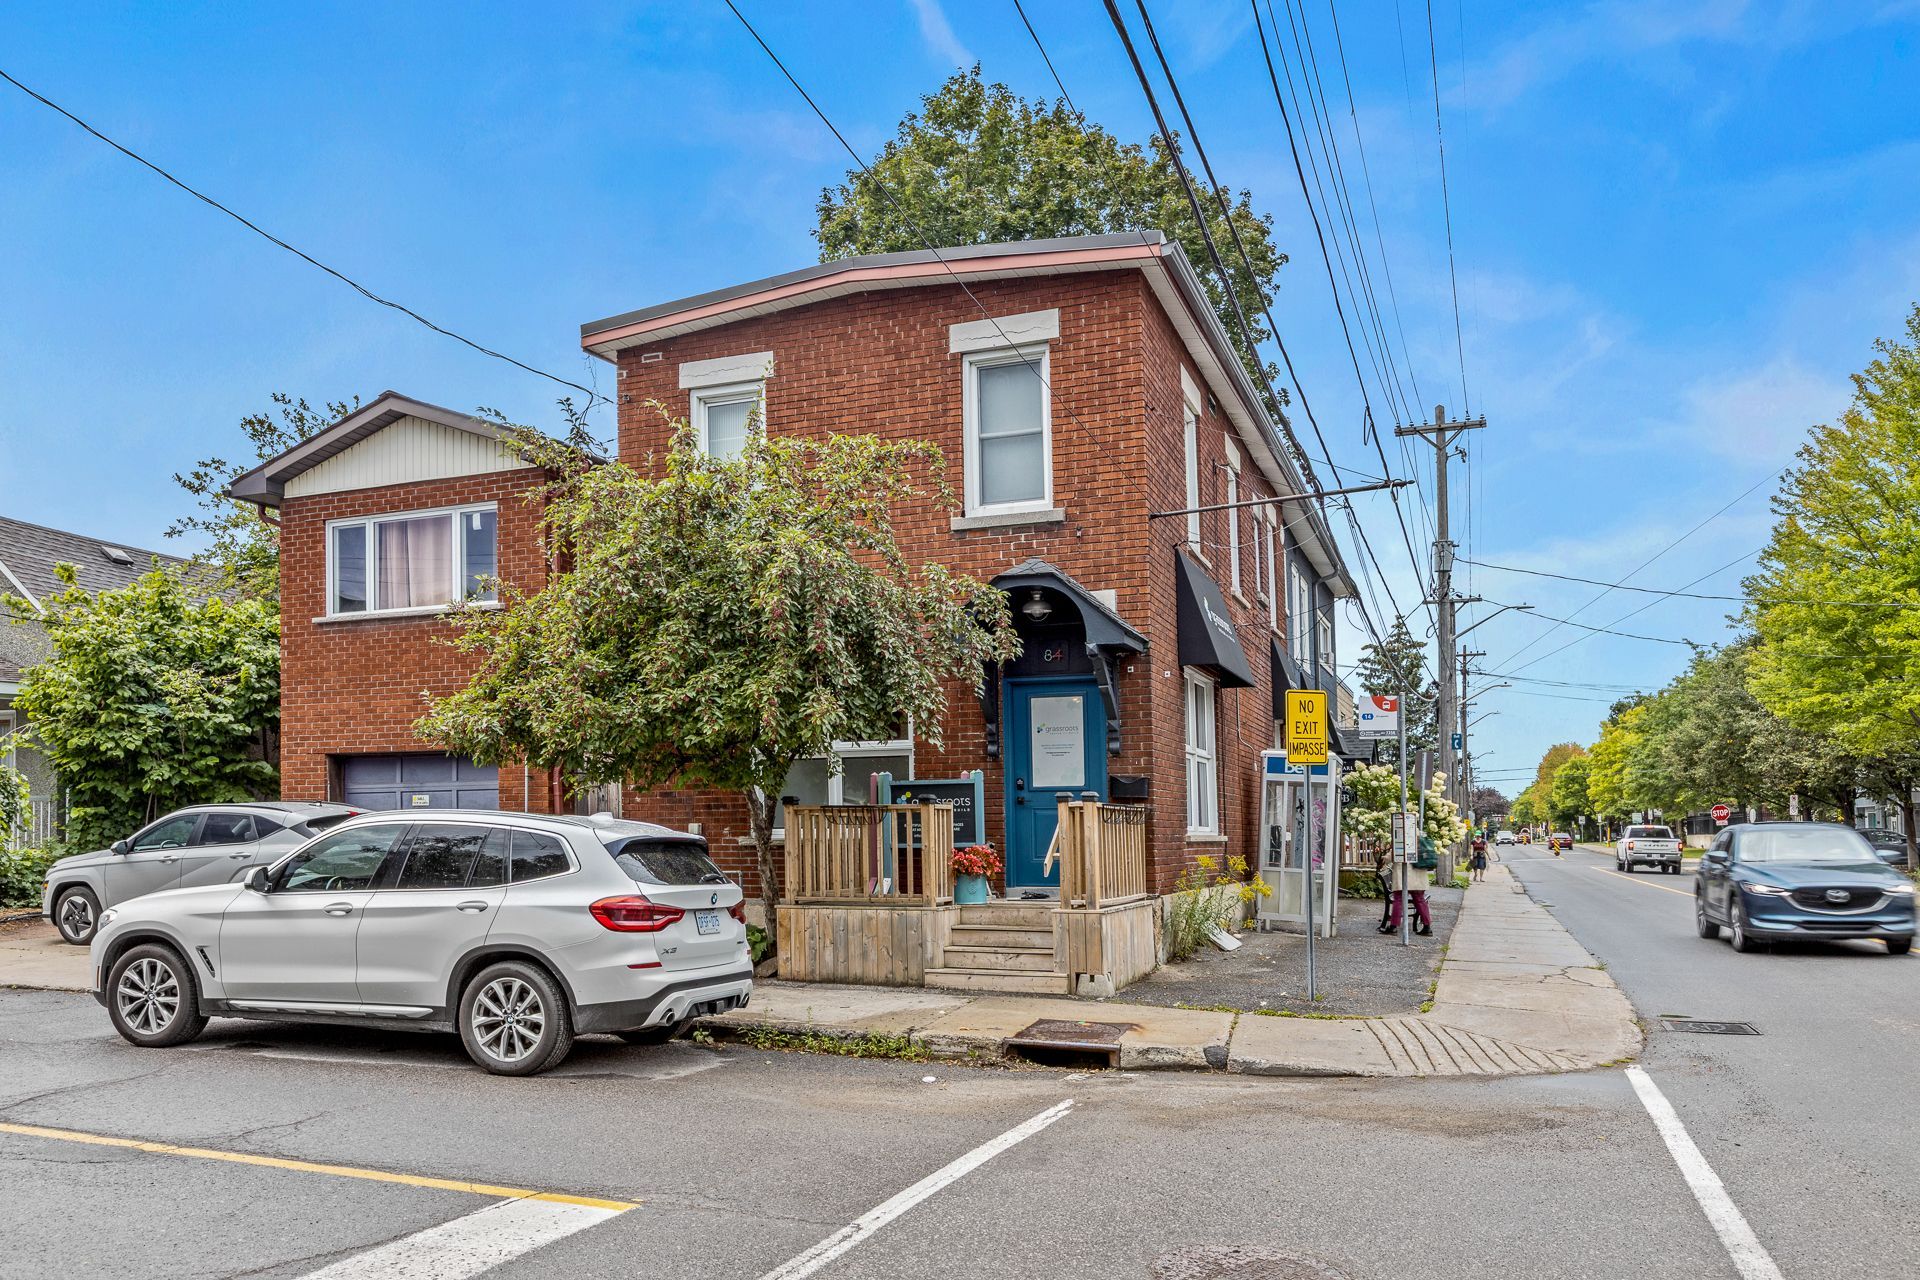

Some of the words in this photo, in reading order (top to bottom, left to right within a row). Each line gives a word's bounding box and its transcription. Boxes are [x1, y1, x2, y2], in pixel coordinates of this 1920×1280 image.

[1044, 649, 1064, 661] 84
[1299, 699, 1315, 714] NO
[1295, 721, 1319, 735] EXIT
[1289, 742, 1325, 756] IMPASSE
[1712, 809, 1729, 817] STOP
[661, 946, 678, 956] X3
